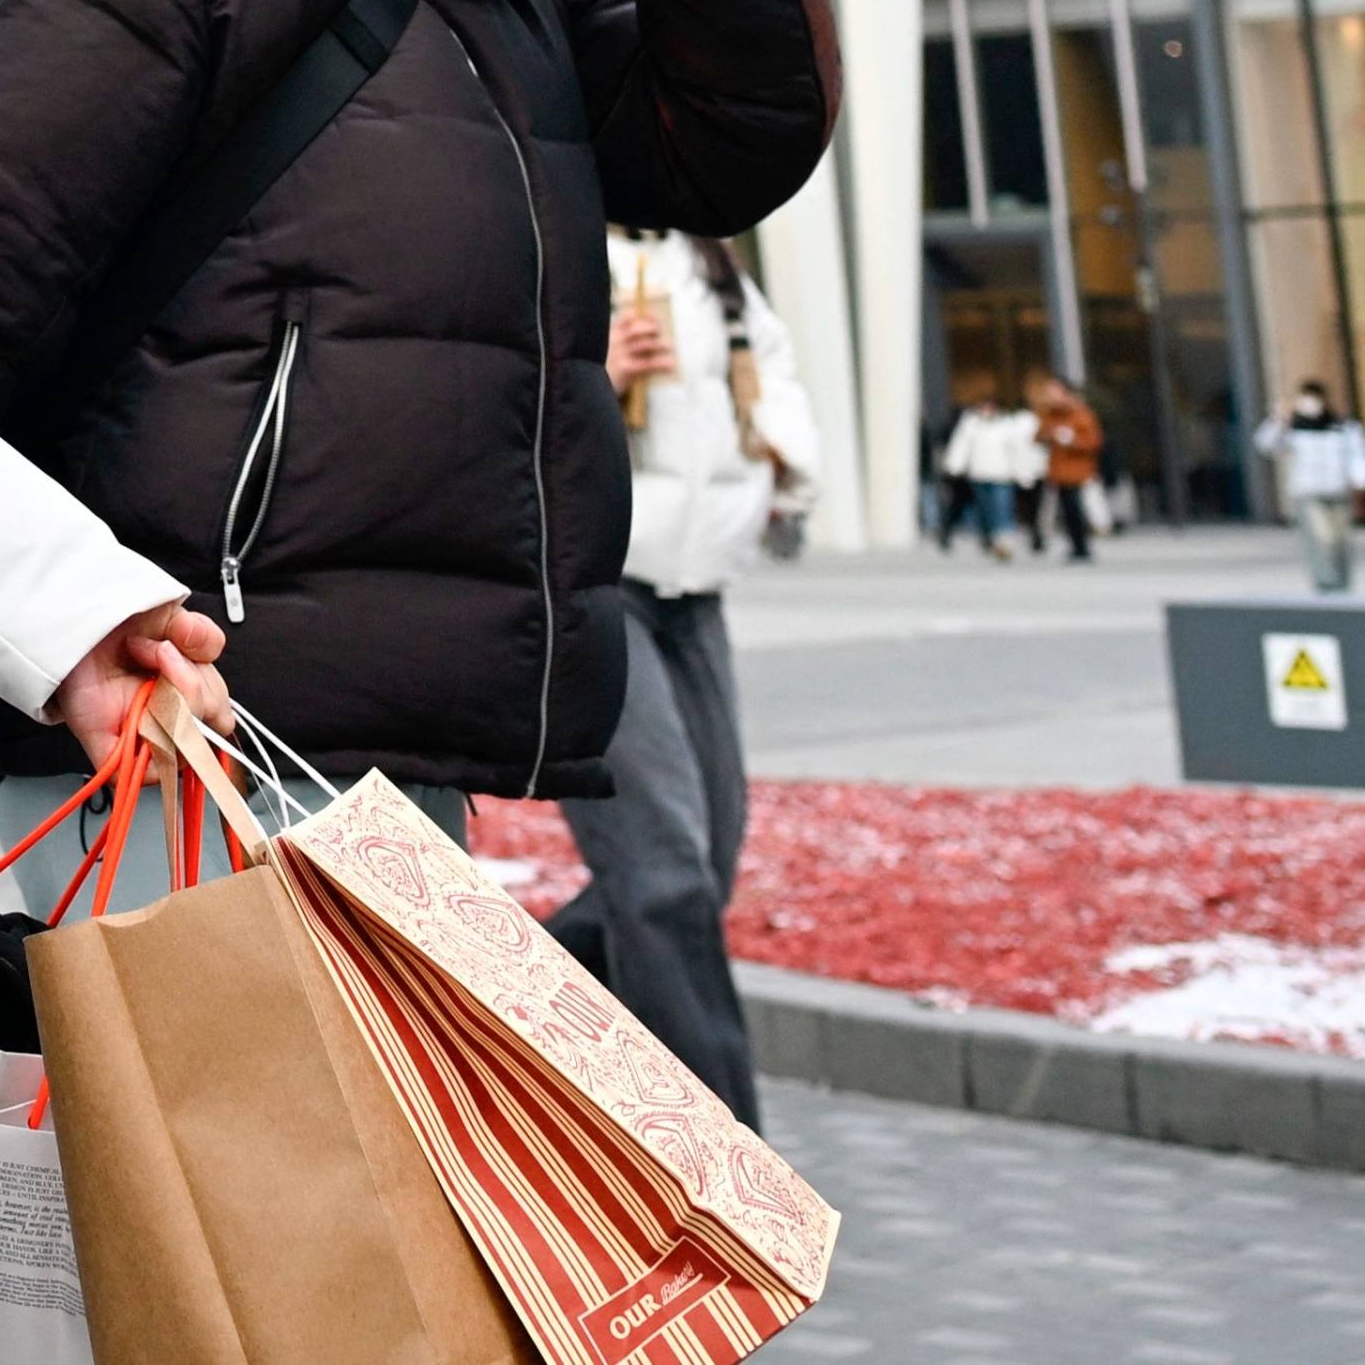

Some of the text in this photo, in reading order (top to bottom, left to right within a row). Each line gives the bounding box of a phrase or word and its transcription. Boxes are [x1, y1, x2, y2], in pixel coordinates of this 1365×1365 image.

[547, 980, 616, 1043] OUR
[609, 1260, 696, 1340] OUR Bakery
